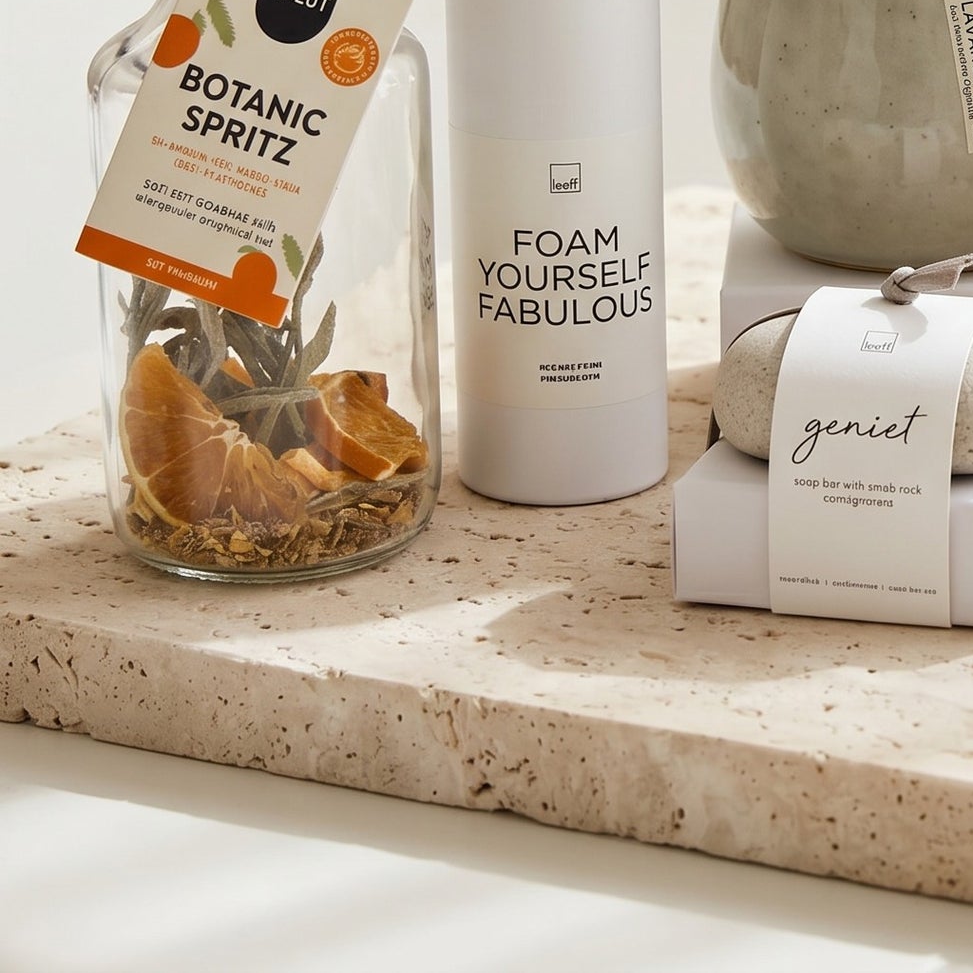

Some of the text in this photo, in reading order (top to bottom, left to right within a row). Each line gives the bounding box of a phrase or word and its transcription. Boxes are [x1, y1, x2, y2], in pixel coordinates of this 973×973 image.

[179, 63, 328, 137] BOTANIC
[181, 105, 298, 166] SPRITZ
[552, 178, 578, 191] leeff
[514, 225, 619, 257] FOAM
[478, 251, 650, 291] YOURSELF
[478, 286, 652, 326] FABULOUS
[791, 405, 928, 464] geniet
[794, 478, 820, 489] soap
[822, 478, 841, 489] bar
[843, 479, 865, 491] with
[899, 484, 922, 495] rock
